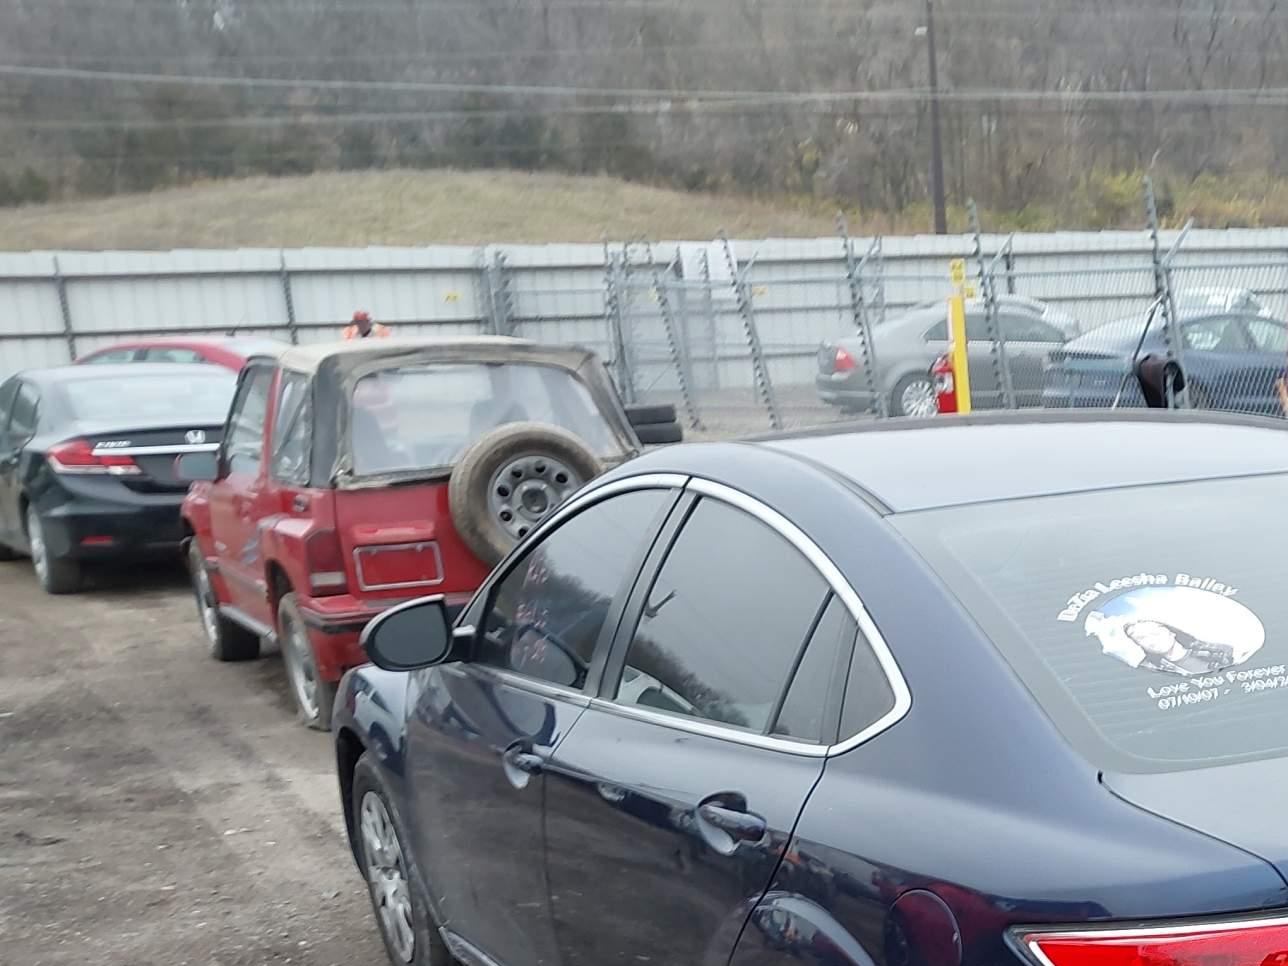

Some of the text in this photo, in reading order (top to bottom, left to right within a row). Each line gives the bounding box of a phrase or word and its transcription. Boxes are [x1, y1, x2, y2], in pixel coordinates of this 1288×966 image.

[1175, 573, 1240, 597] Bailey
[1147, 664, 1286, 699] Love You Forever
